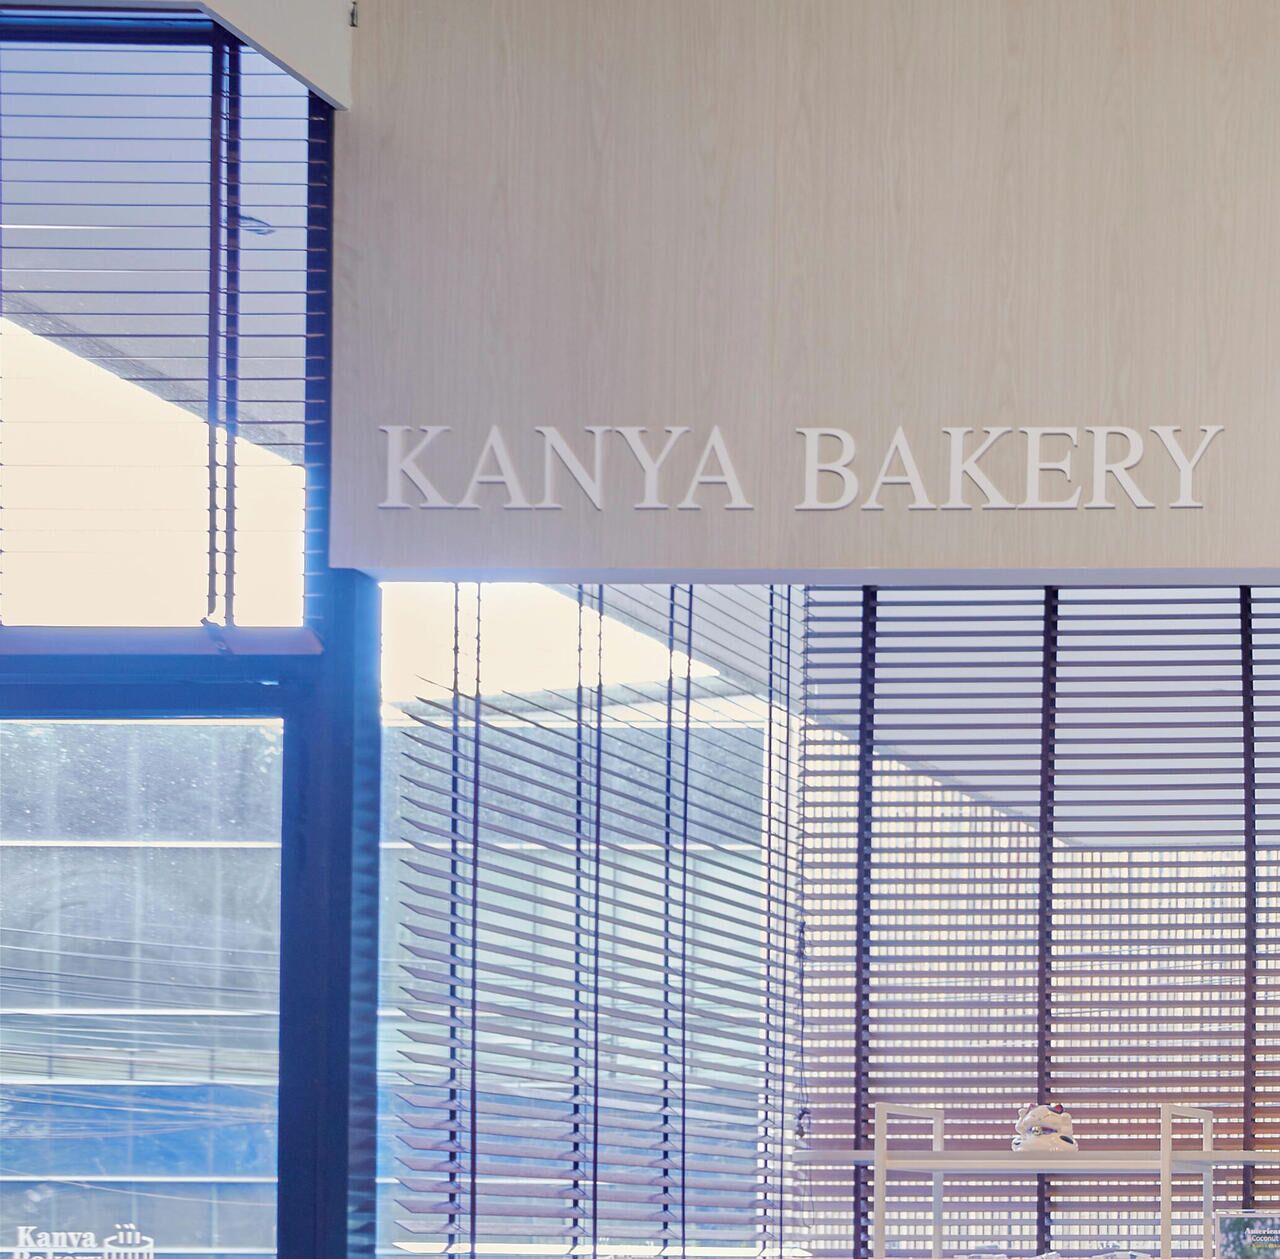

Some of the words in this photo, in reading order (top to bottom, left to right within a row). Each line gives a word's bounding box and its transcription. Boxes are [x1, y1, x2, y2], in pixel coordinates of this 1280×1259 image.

[376, 424, 755, 512] KANYA
[793, 424, 1226, 512] BAKERY
[16, 1226, 98, 1254] Kanya
